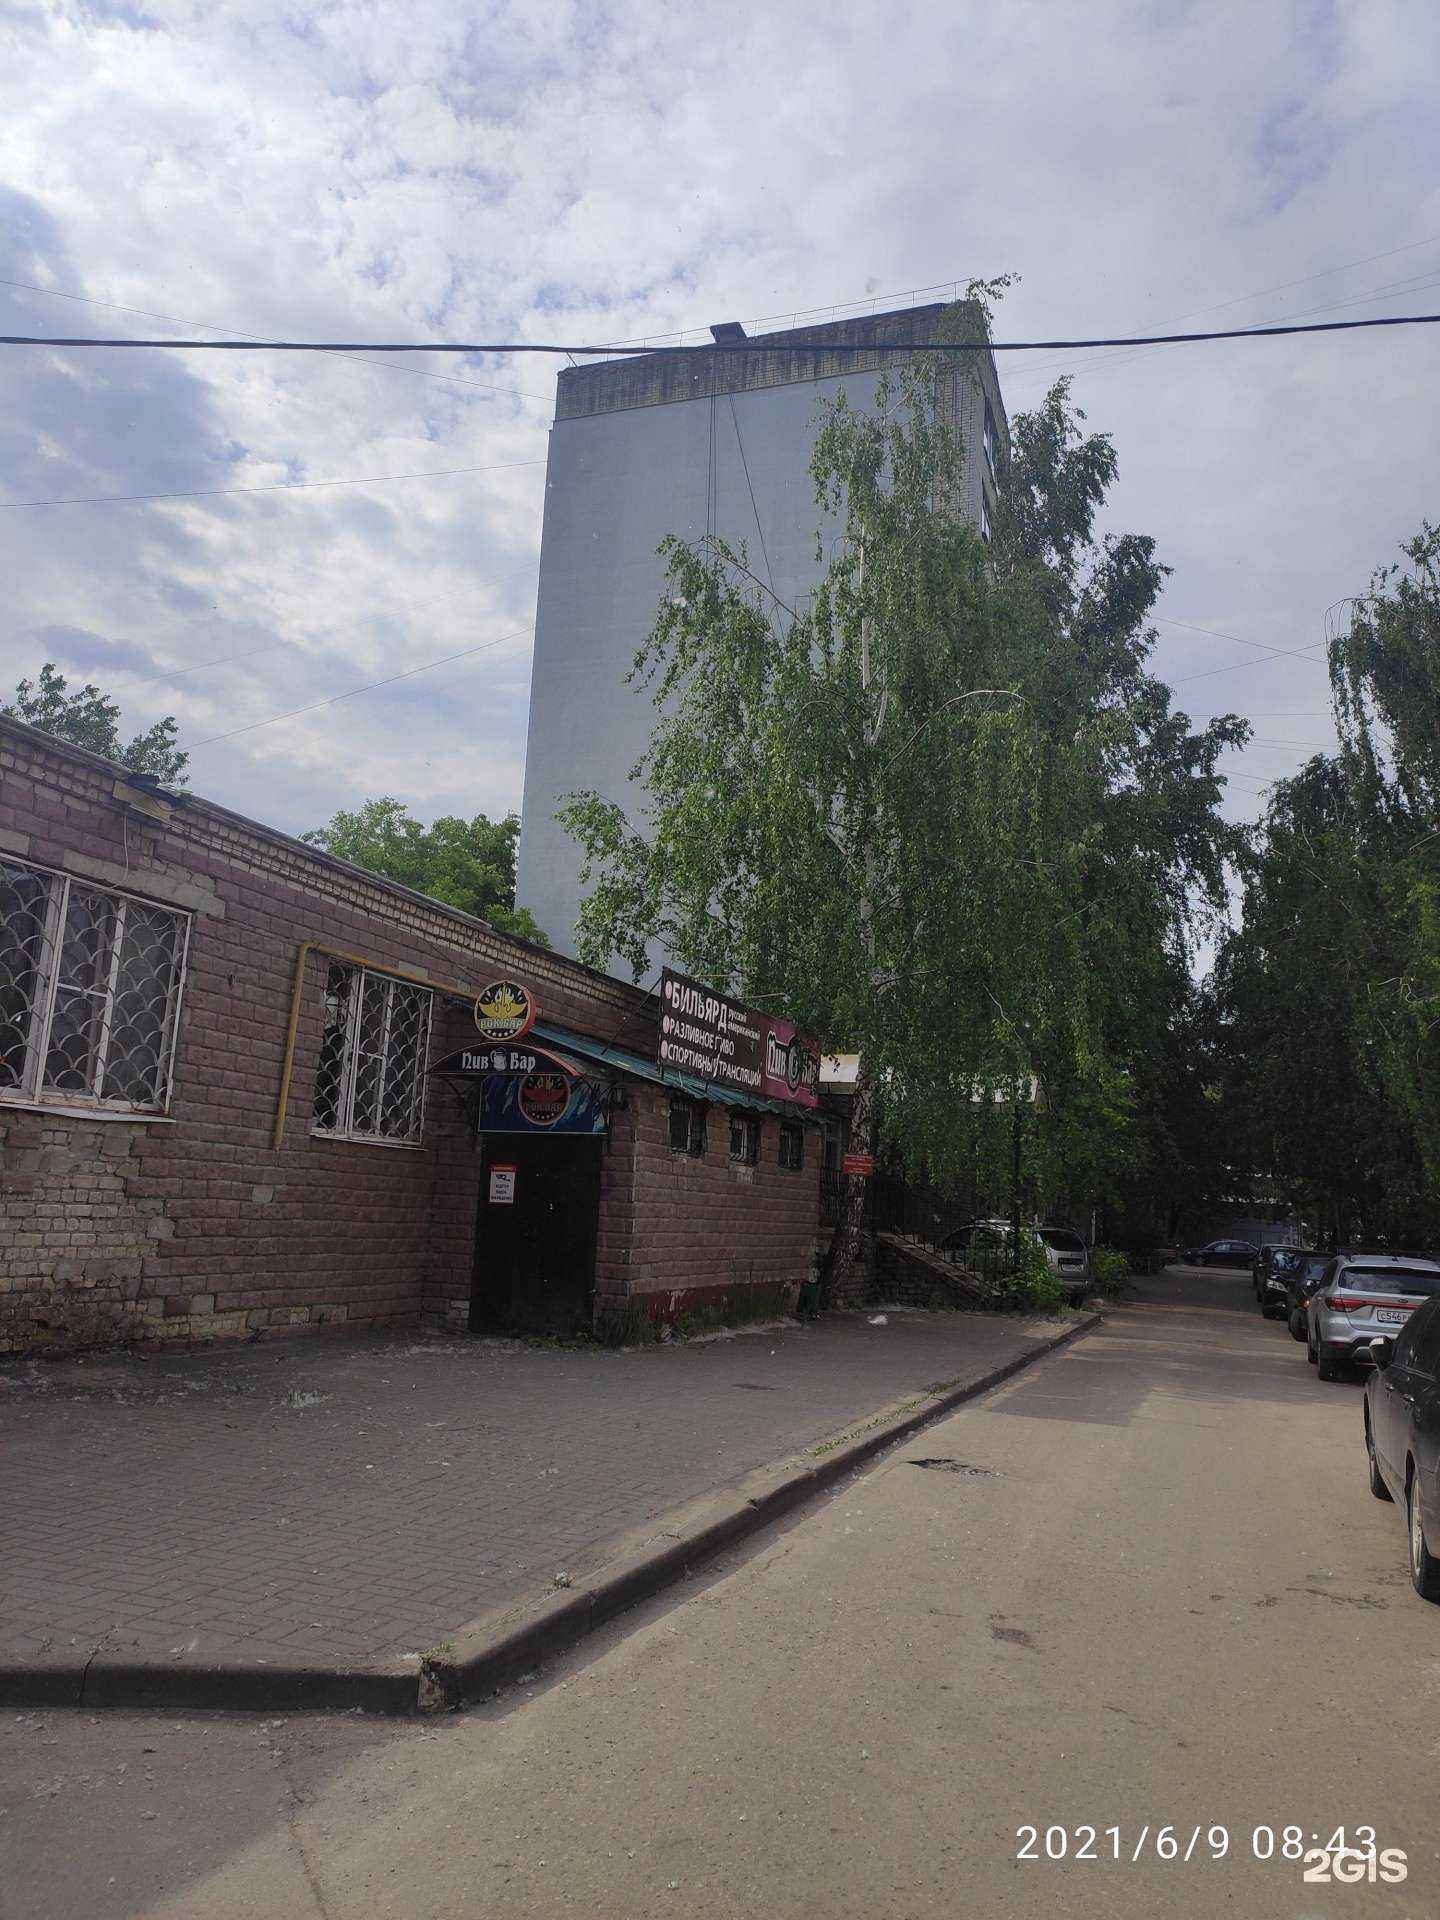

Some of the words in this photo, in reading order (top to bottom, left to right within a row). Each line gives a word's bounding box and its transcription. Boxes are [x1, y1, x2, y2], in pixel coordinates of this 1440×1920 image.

[671, 981, 728, 1034] БИЛЬЯРД
[669, 1018, 713, 1049] РАЗЛИВНОЕ
[462, 1052, 489, 1070] Пив
[510, 1052, 536, 1074] Бар
